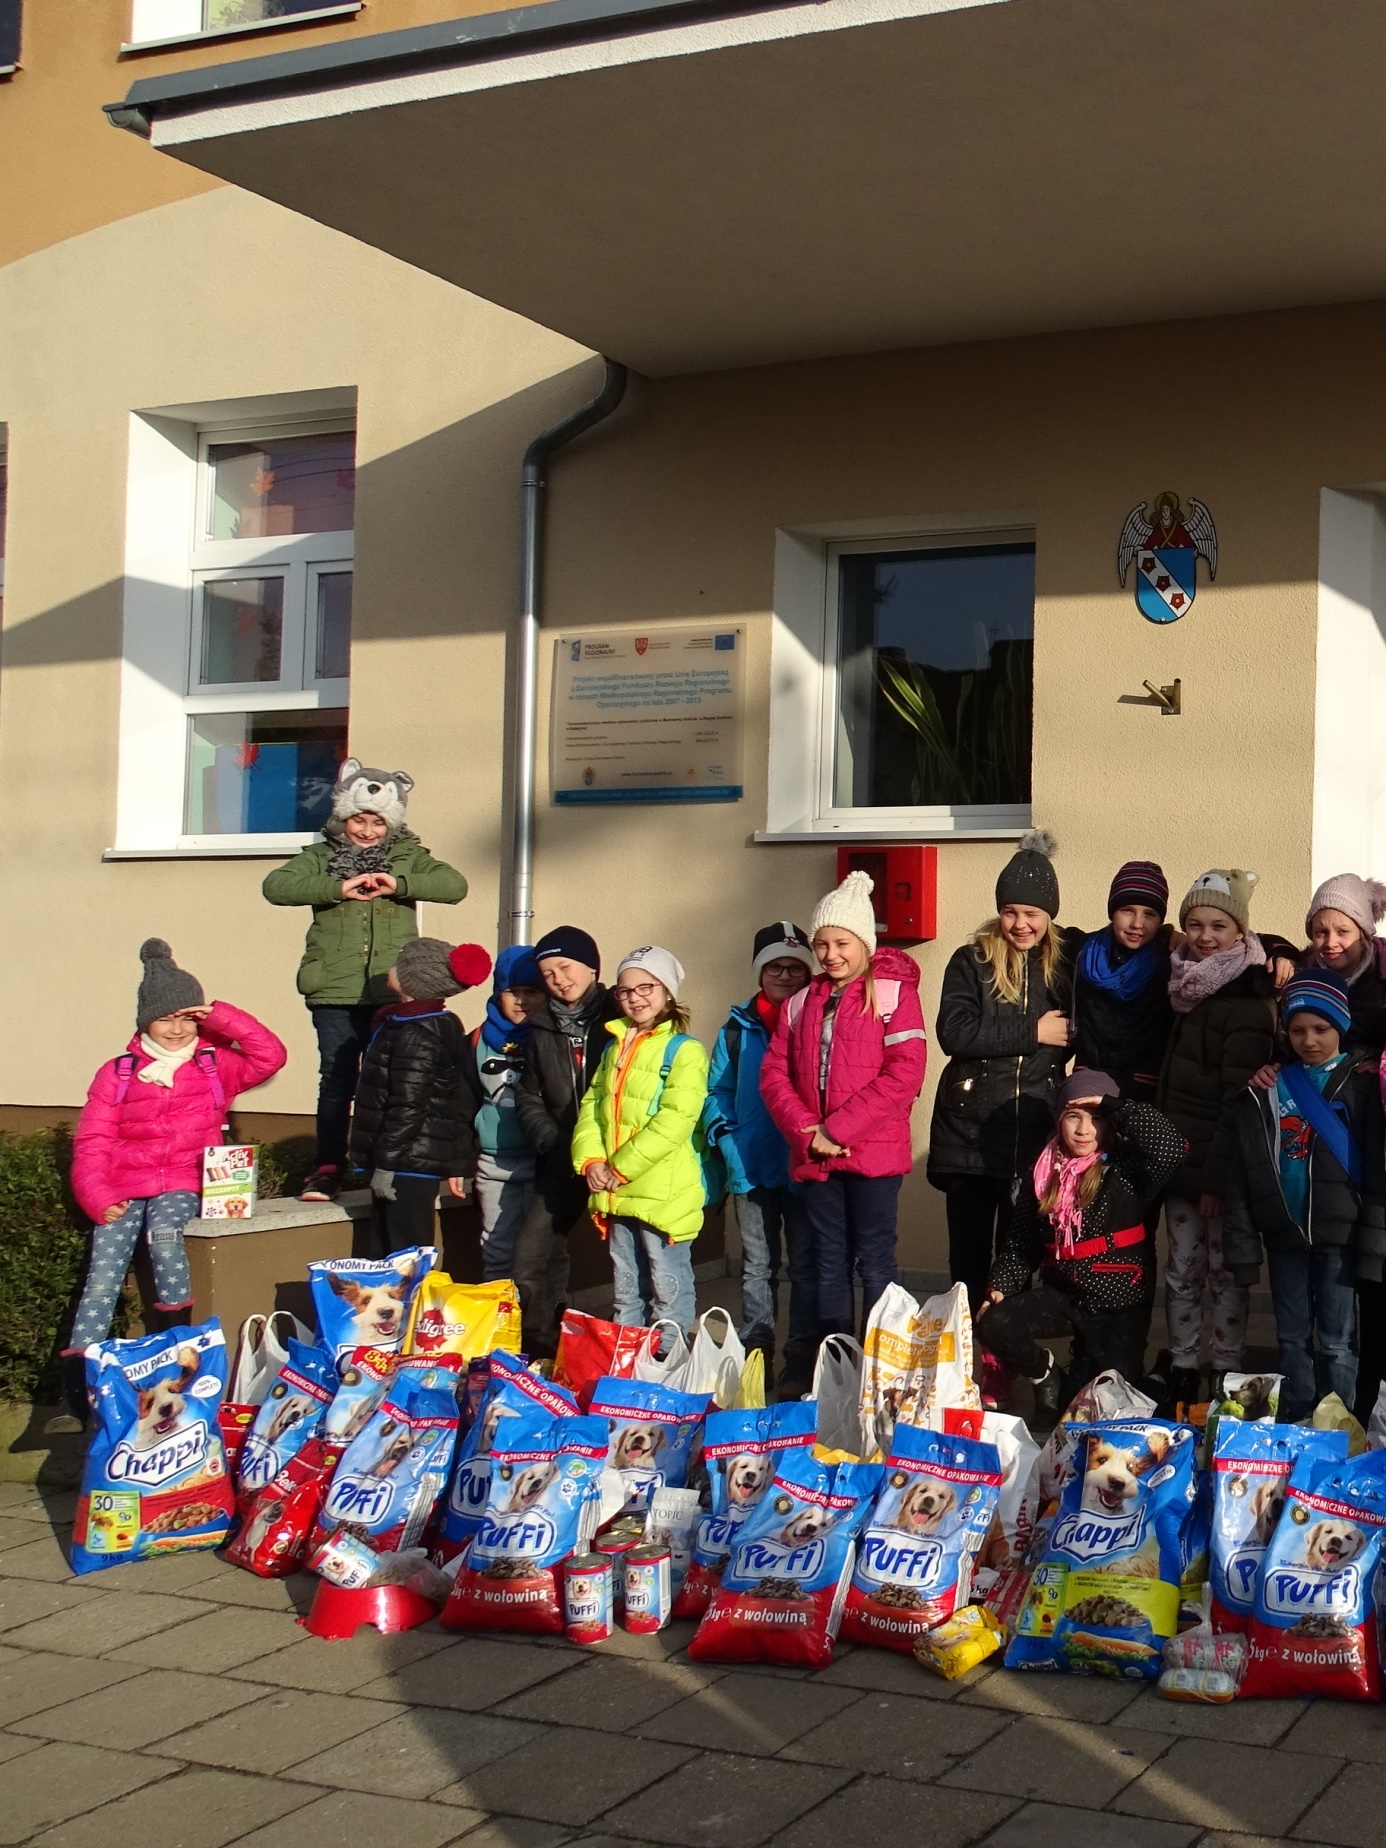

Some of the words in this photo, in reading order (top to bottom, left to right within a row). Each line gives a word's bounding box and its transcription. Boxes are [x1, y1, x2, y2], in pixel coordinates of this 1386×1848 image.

[414, 1320, 467, 1337] edigree
[151, 1350, 173, 1372] PACK
[107, 1429, 202, 1480] Chappi
[896, 1458, 946, 1477] EKONOMICZNE
[94, 1495, 113, 1511] 30
[475, 1515, 547, 1549] PUFFi
[1051, 1515, 1139, 1550] Chappi
[865, 1537, 938, 1580] PUFFi
[1033, 1568, 1048, 1586] 30
[569, 1602, 597, 1616] PUFFi
[744, 1607, 808, 1626] wołowiną
